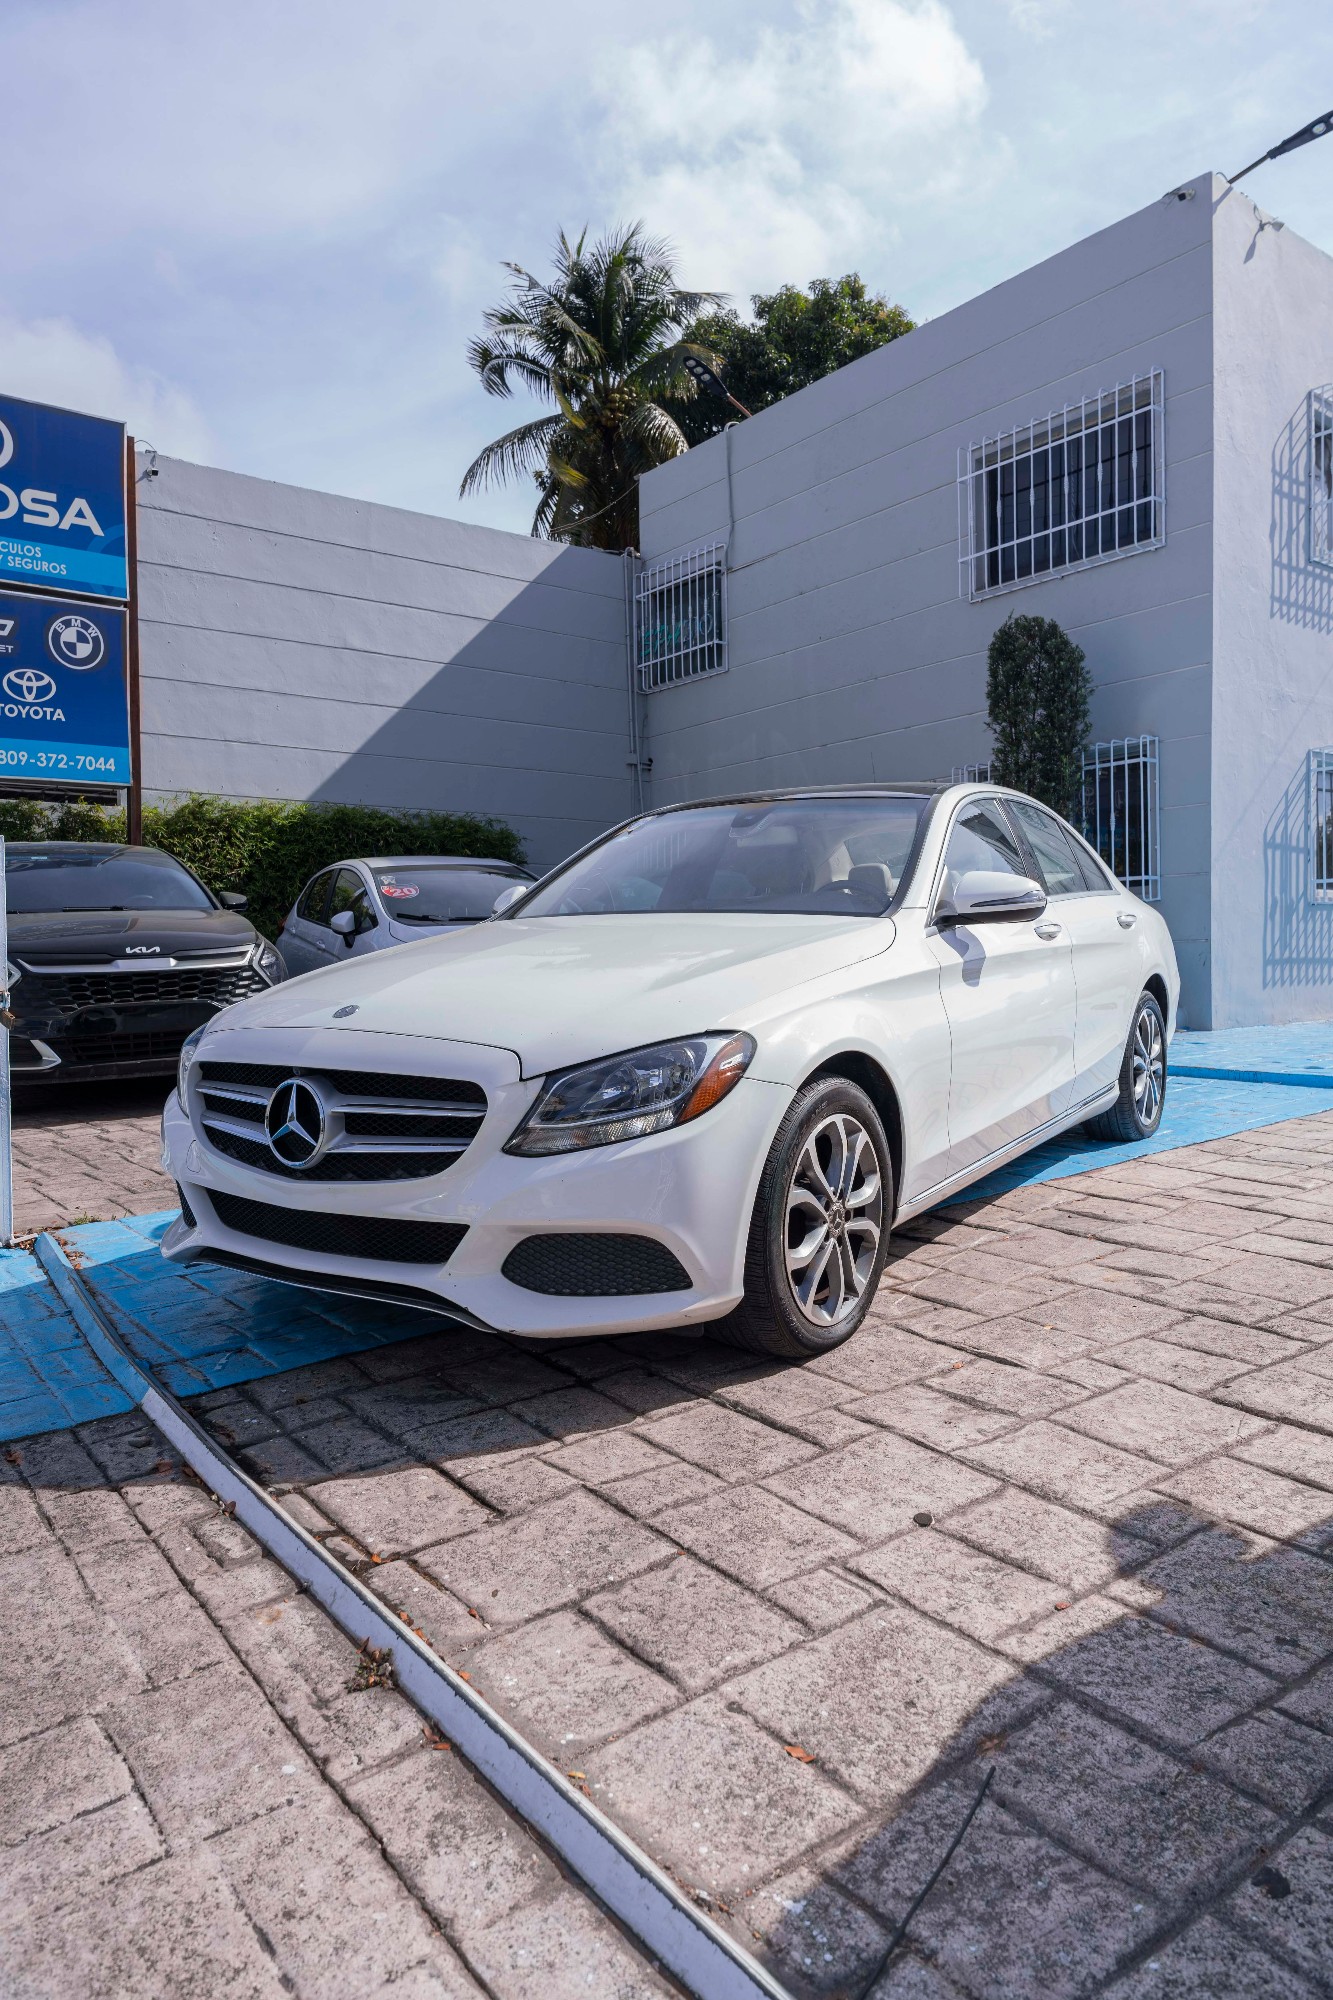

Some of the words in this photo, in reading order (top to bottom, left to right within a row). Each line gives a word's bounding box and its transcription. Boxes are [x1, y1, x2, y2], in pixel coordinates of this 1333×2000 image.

[7, 556, 67, 575] SEGUROS
[55, 618, 98, 637] BMW
[0, 749, 115, 771] 809-372-7044
[125, 946, 160, 954] KIA
